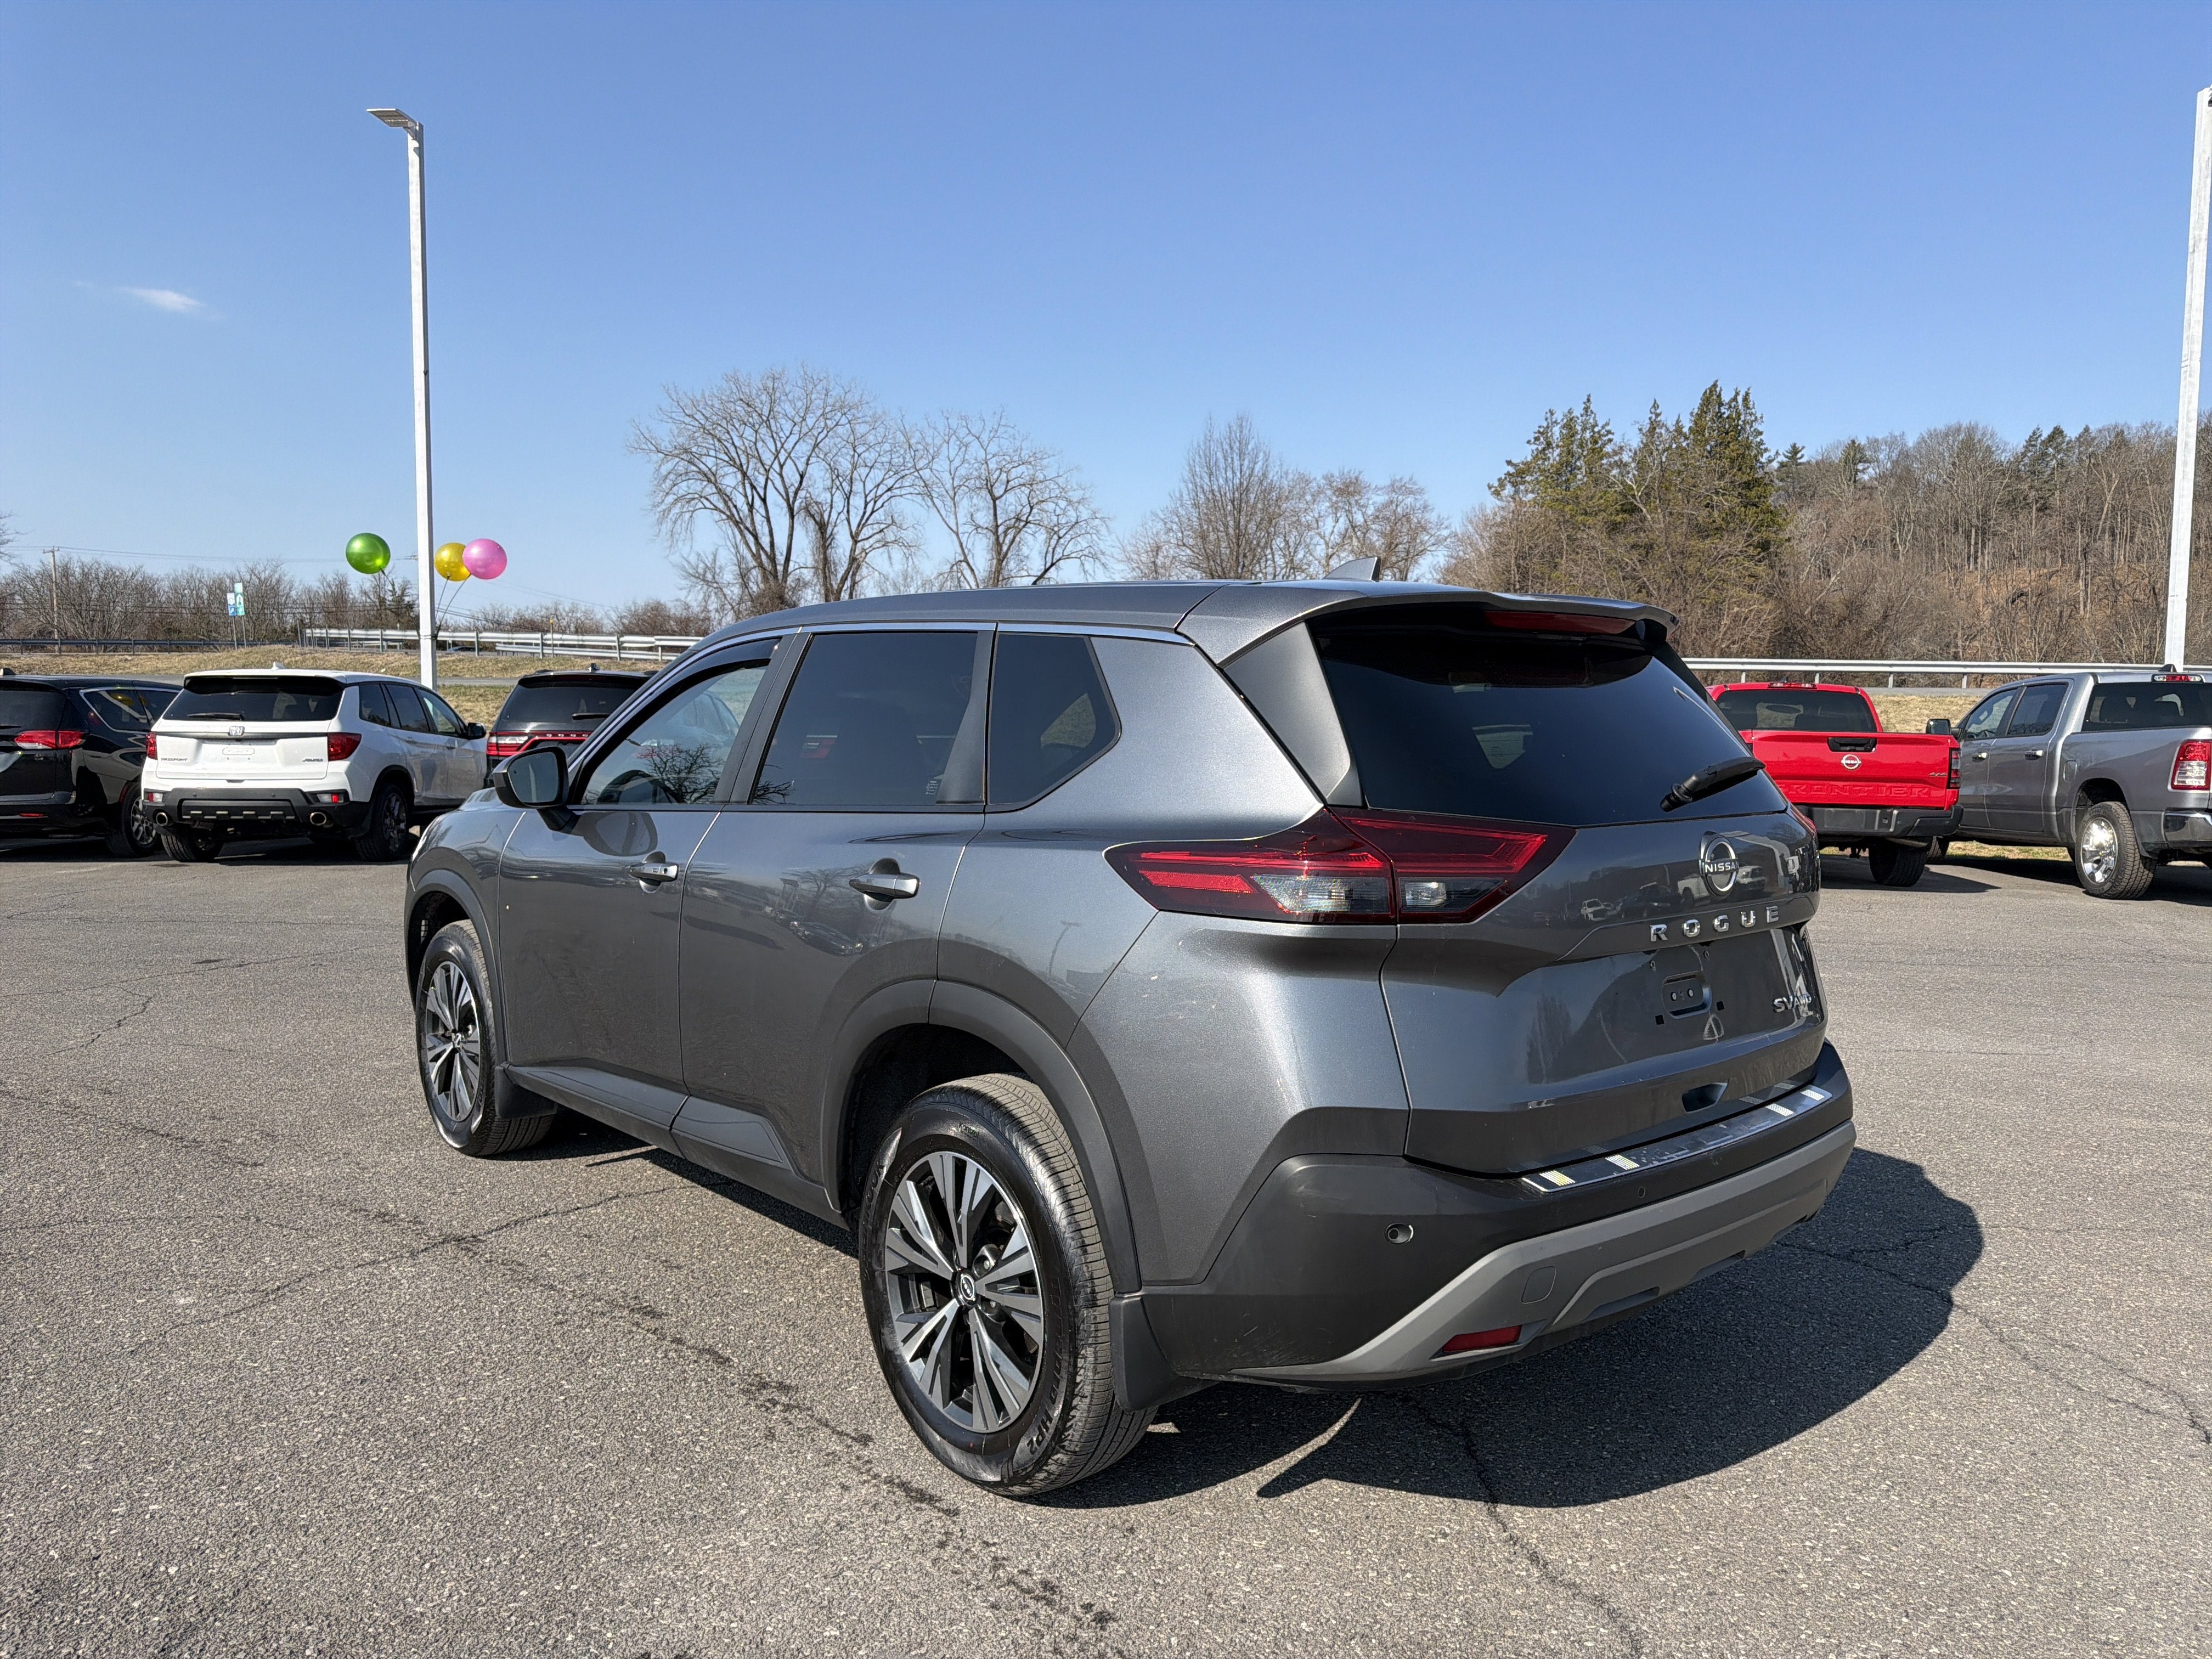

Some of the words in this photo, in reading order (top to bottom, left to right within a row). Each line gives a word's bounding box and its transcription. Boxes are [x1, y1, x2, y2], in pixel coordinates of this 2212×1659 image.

[1705, 861, 1740, 873] NISSAN
[1650, 906, 1779, 942] ROGUE
[1773, 995, 1793, 1013] SV
[1026, 1408, 1053, 1455] HP2
